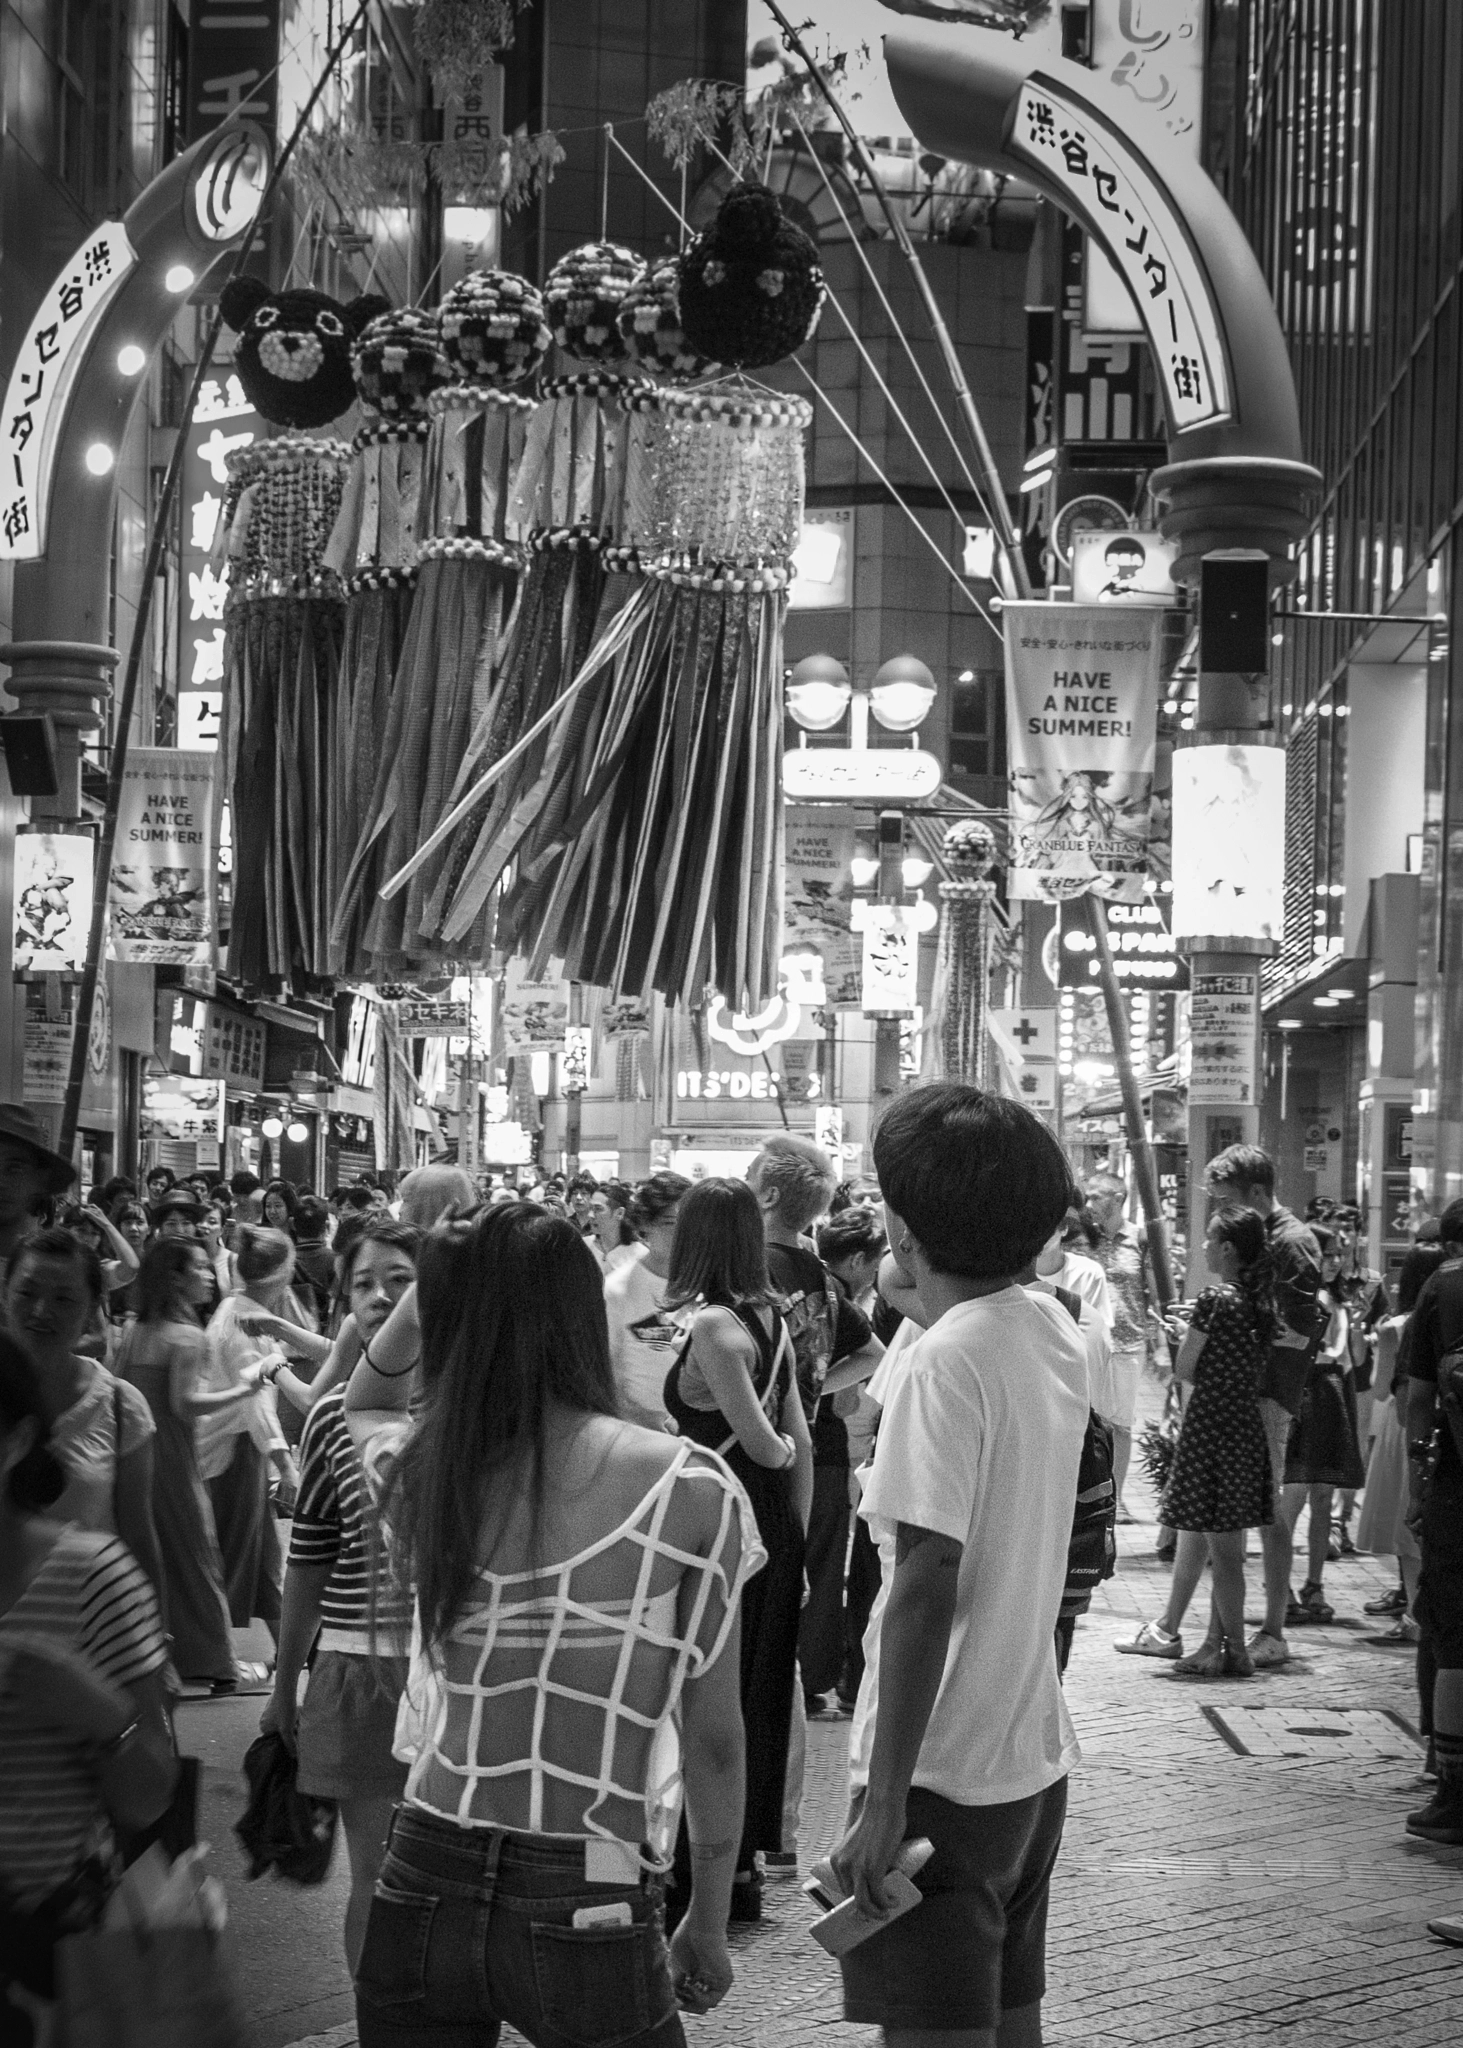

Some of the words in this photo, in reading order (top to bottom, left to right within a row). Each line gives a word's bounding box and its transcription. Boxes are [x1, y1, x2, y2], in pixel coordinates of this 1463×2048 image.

[1027, 100, 1202, 405] 渋谷センター街
[3, 240, 112, 548] 渋谷センター街
[1053, 671, 1112, 689] HAVE
[1043, 695, 1058, 712] A
[1064, 695, 1118, 713] NICE
[1028, 717, 1132, 737] SUMMER!
[147, 795, 189, 808] HAVE
[140, 812, 152, 824] A
[155, 812, 194, 827] NICE
[129, 829, 203, 844] SUMMER!
[796, 838, 829, 847] HAVE
[792, 849, 801, 857] A
[804, 850, 833, 858] NICE
[1107, 905, 1161, 924] CLUB
